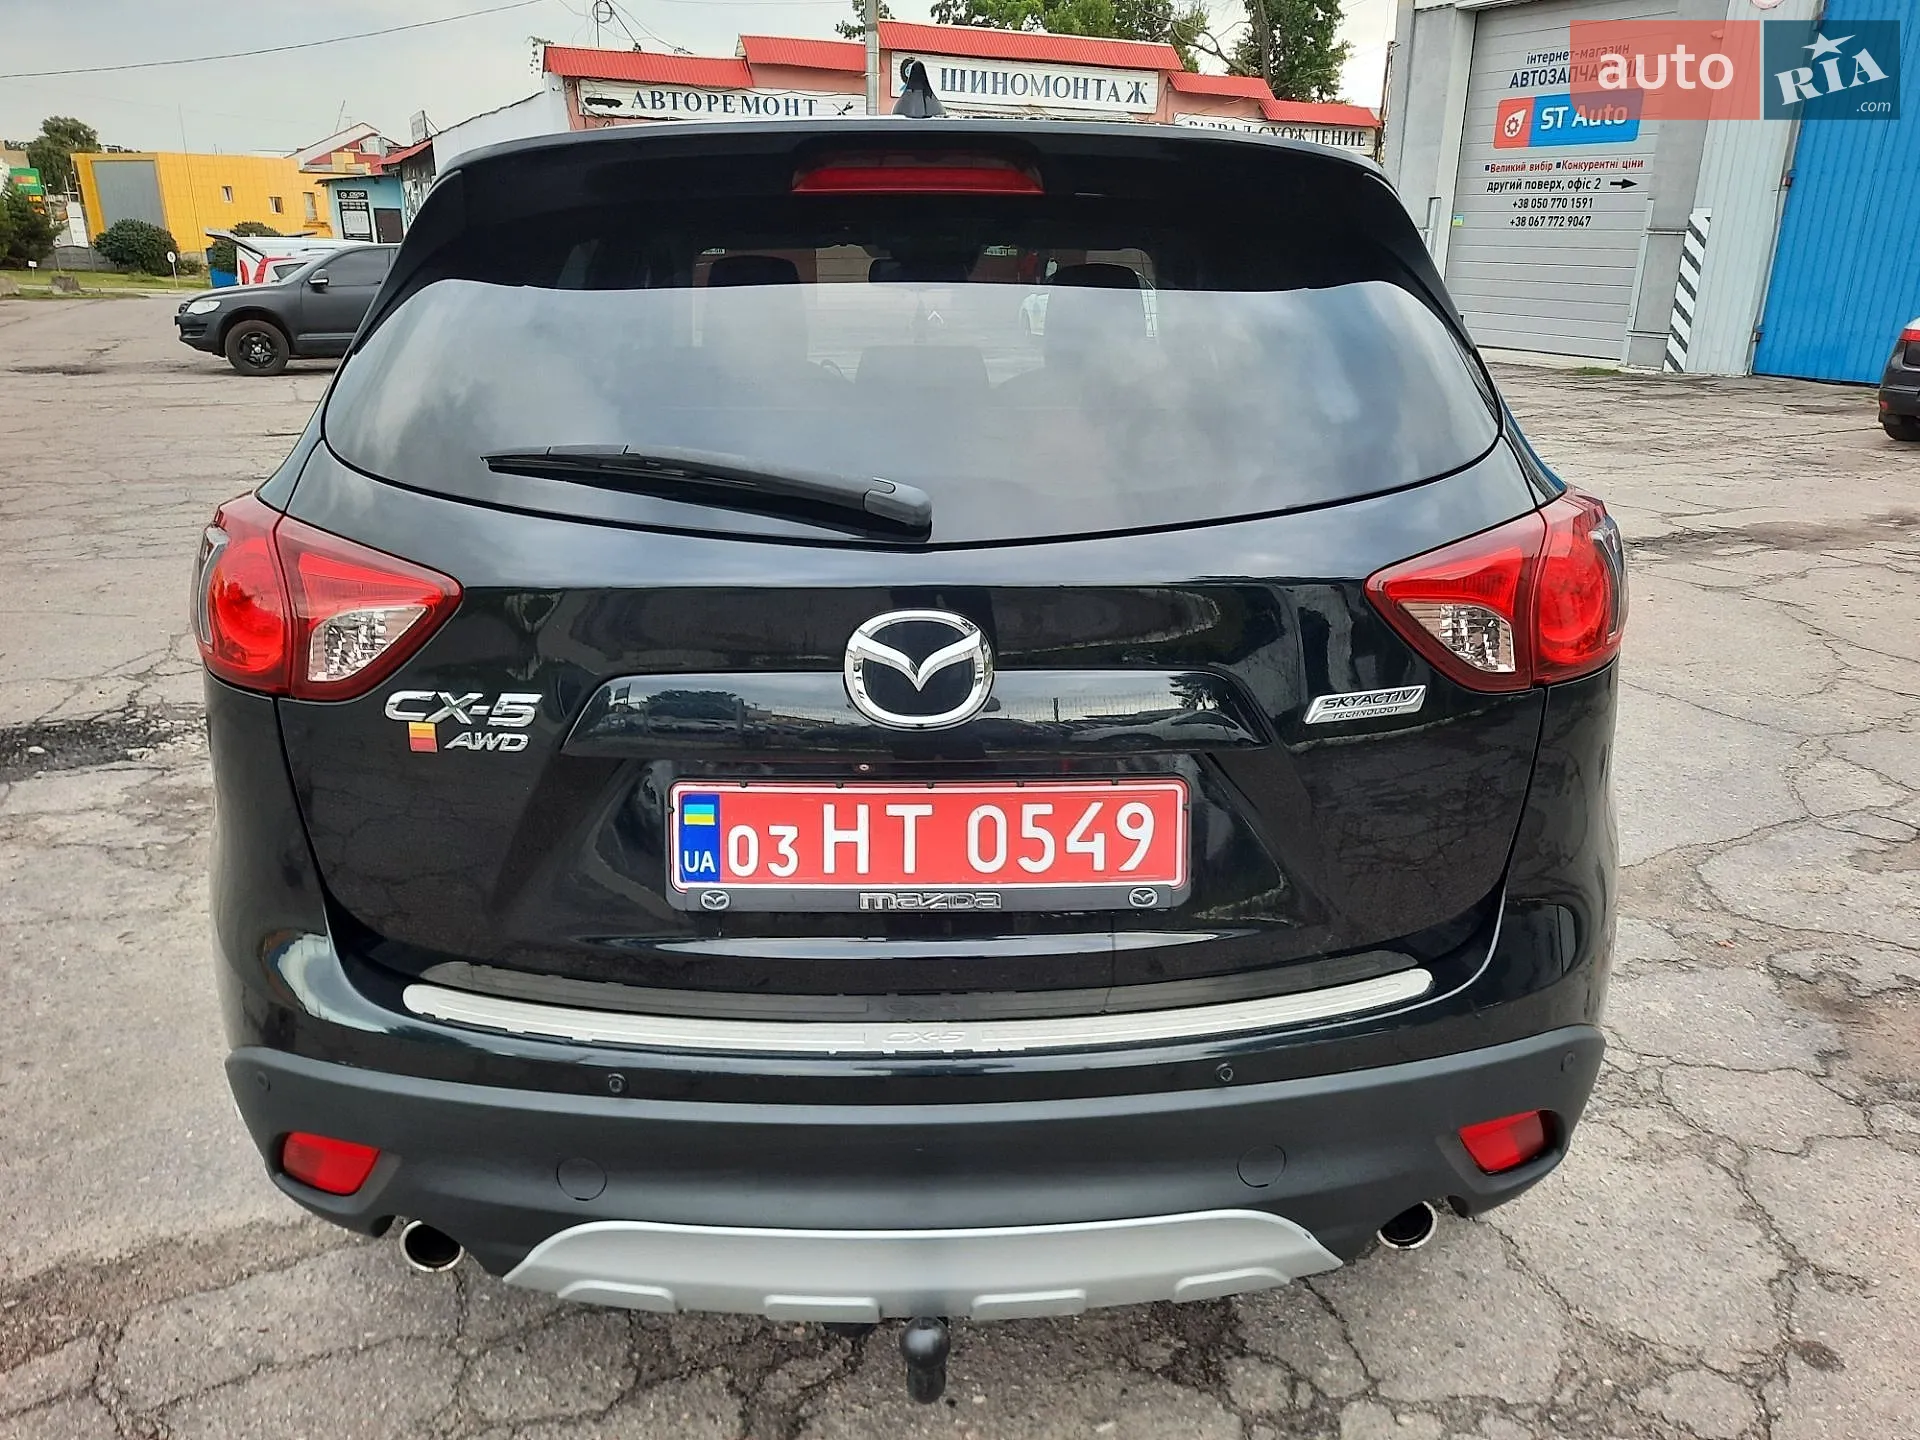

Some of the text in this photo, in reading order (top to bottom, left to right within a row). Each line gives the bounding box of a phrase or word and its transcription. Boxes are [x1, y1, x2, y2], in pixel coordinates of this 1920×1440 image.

[1526, 44, 1630, 66] інтернет-магазин
[939, 67, 1149, 106] ШИНОМОНТАЖ
[630, 89, 818, 117] АВТОРЕМОНТ
[1540, 103, 1628, 130] ST Auto
[1490, 158, 1644, 173] Великий вибір Конкурентні ціни
[1487, 178, 1601, 193] другий поверх, офіс 2
[1512, 197, 1593, 209] +38 050 770 1591
[1510, 215, 1592, 227] +38 067 772 9047
[384, 690, 543, 728] CX-5
[1323, 689, 1418, 710] SKYACTIV
[1332, 706, 1400, 720] TECHNOLOGY
[444, 731, 530, 752] AWD
[727, 801, 1156, 878] 03 HT 0549
[683, 850, 716, 874] UA
[859, 891, 1002, 911] mazda
[883, 1030, 967, 1044] CX-5
